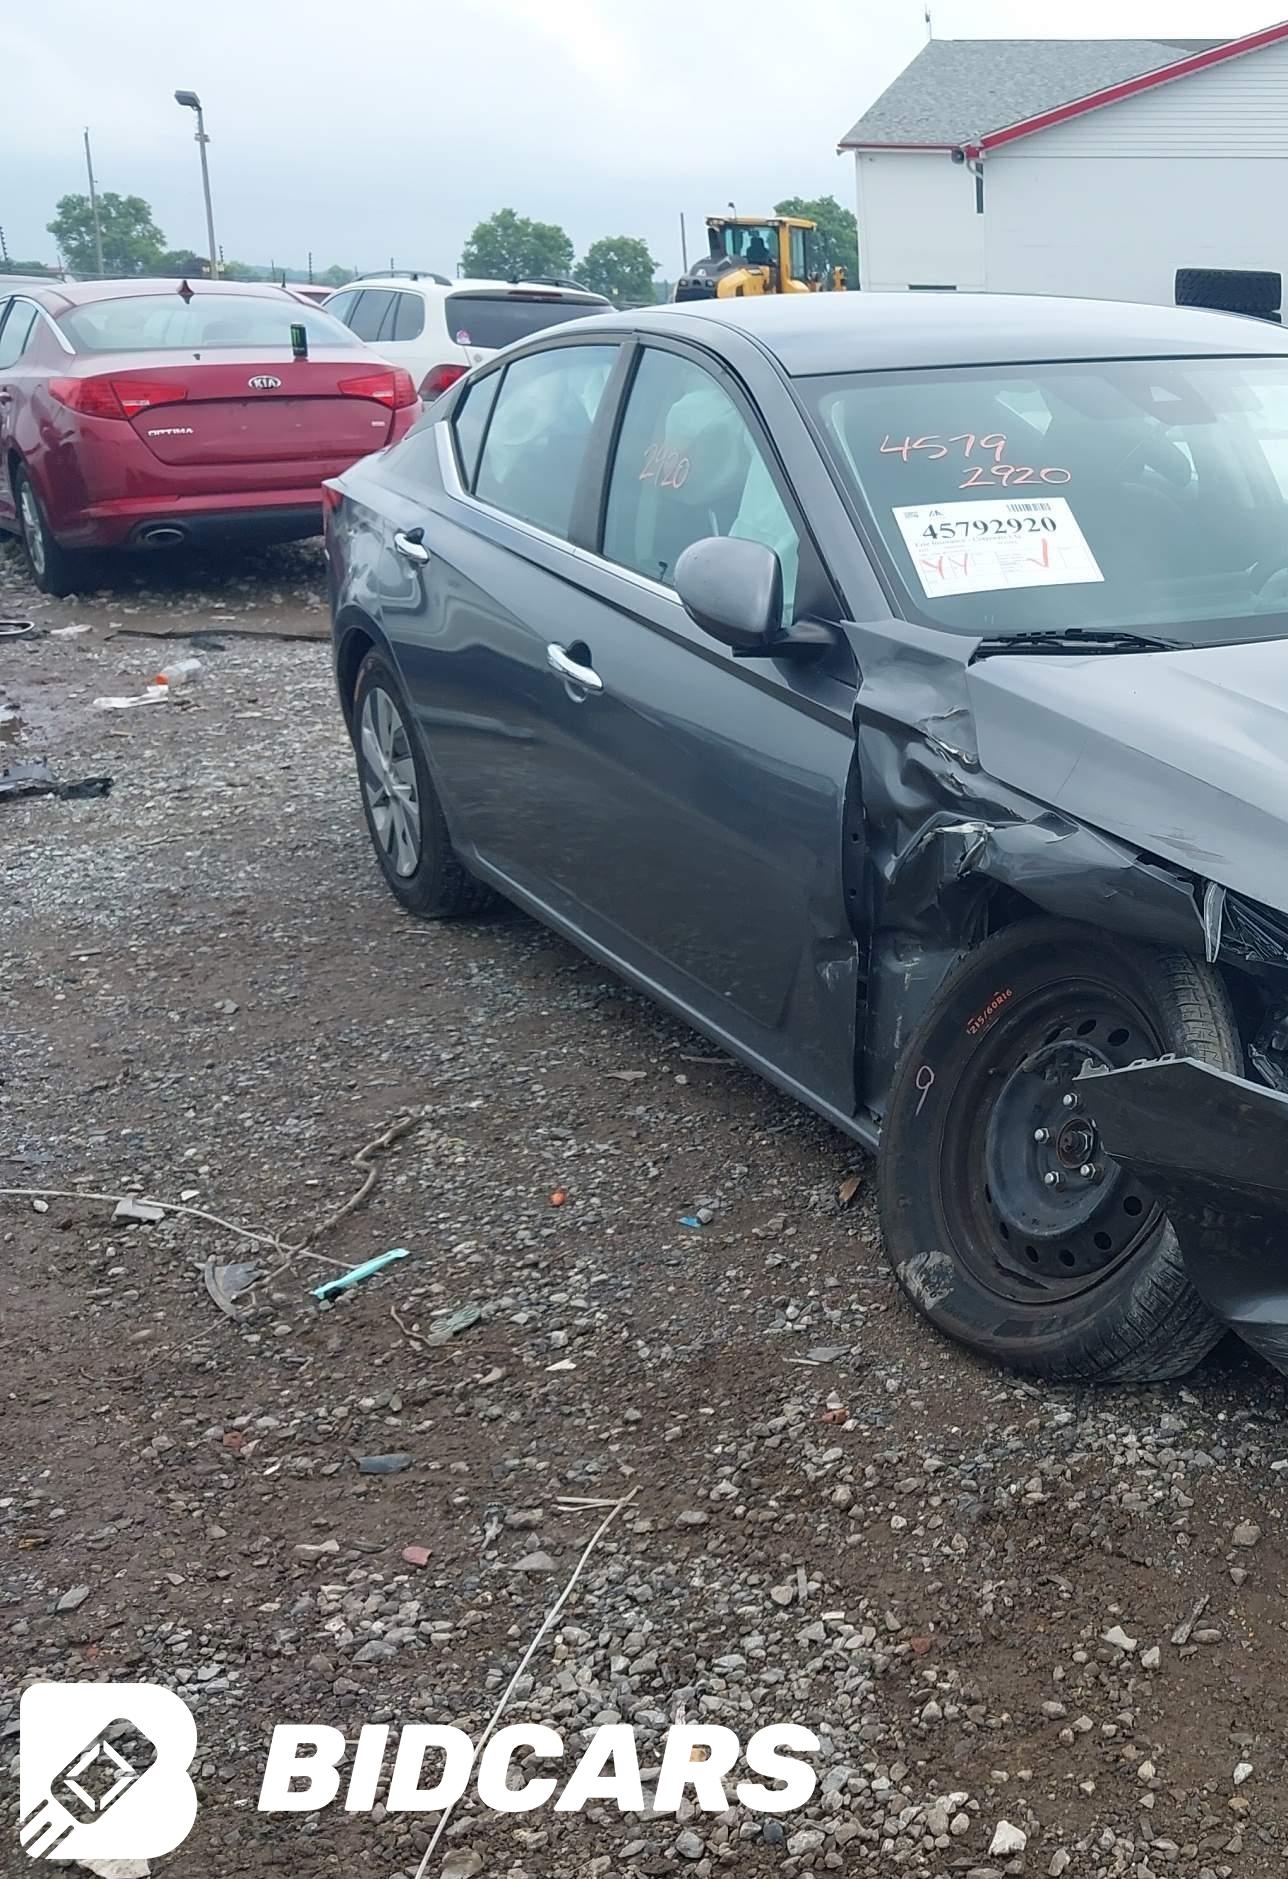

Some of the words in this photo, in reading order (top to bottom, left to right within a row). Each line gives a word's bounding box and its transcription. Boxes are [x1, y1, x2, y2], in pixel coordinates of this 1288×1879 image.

[253, 376, 278, 389] KIA
[879, 433, 1008, 463] 4579
[958, 464, 1072, 490] 2920
[922, 516, 1058, 541] 45792920
